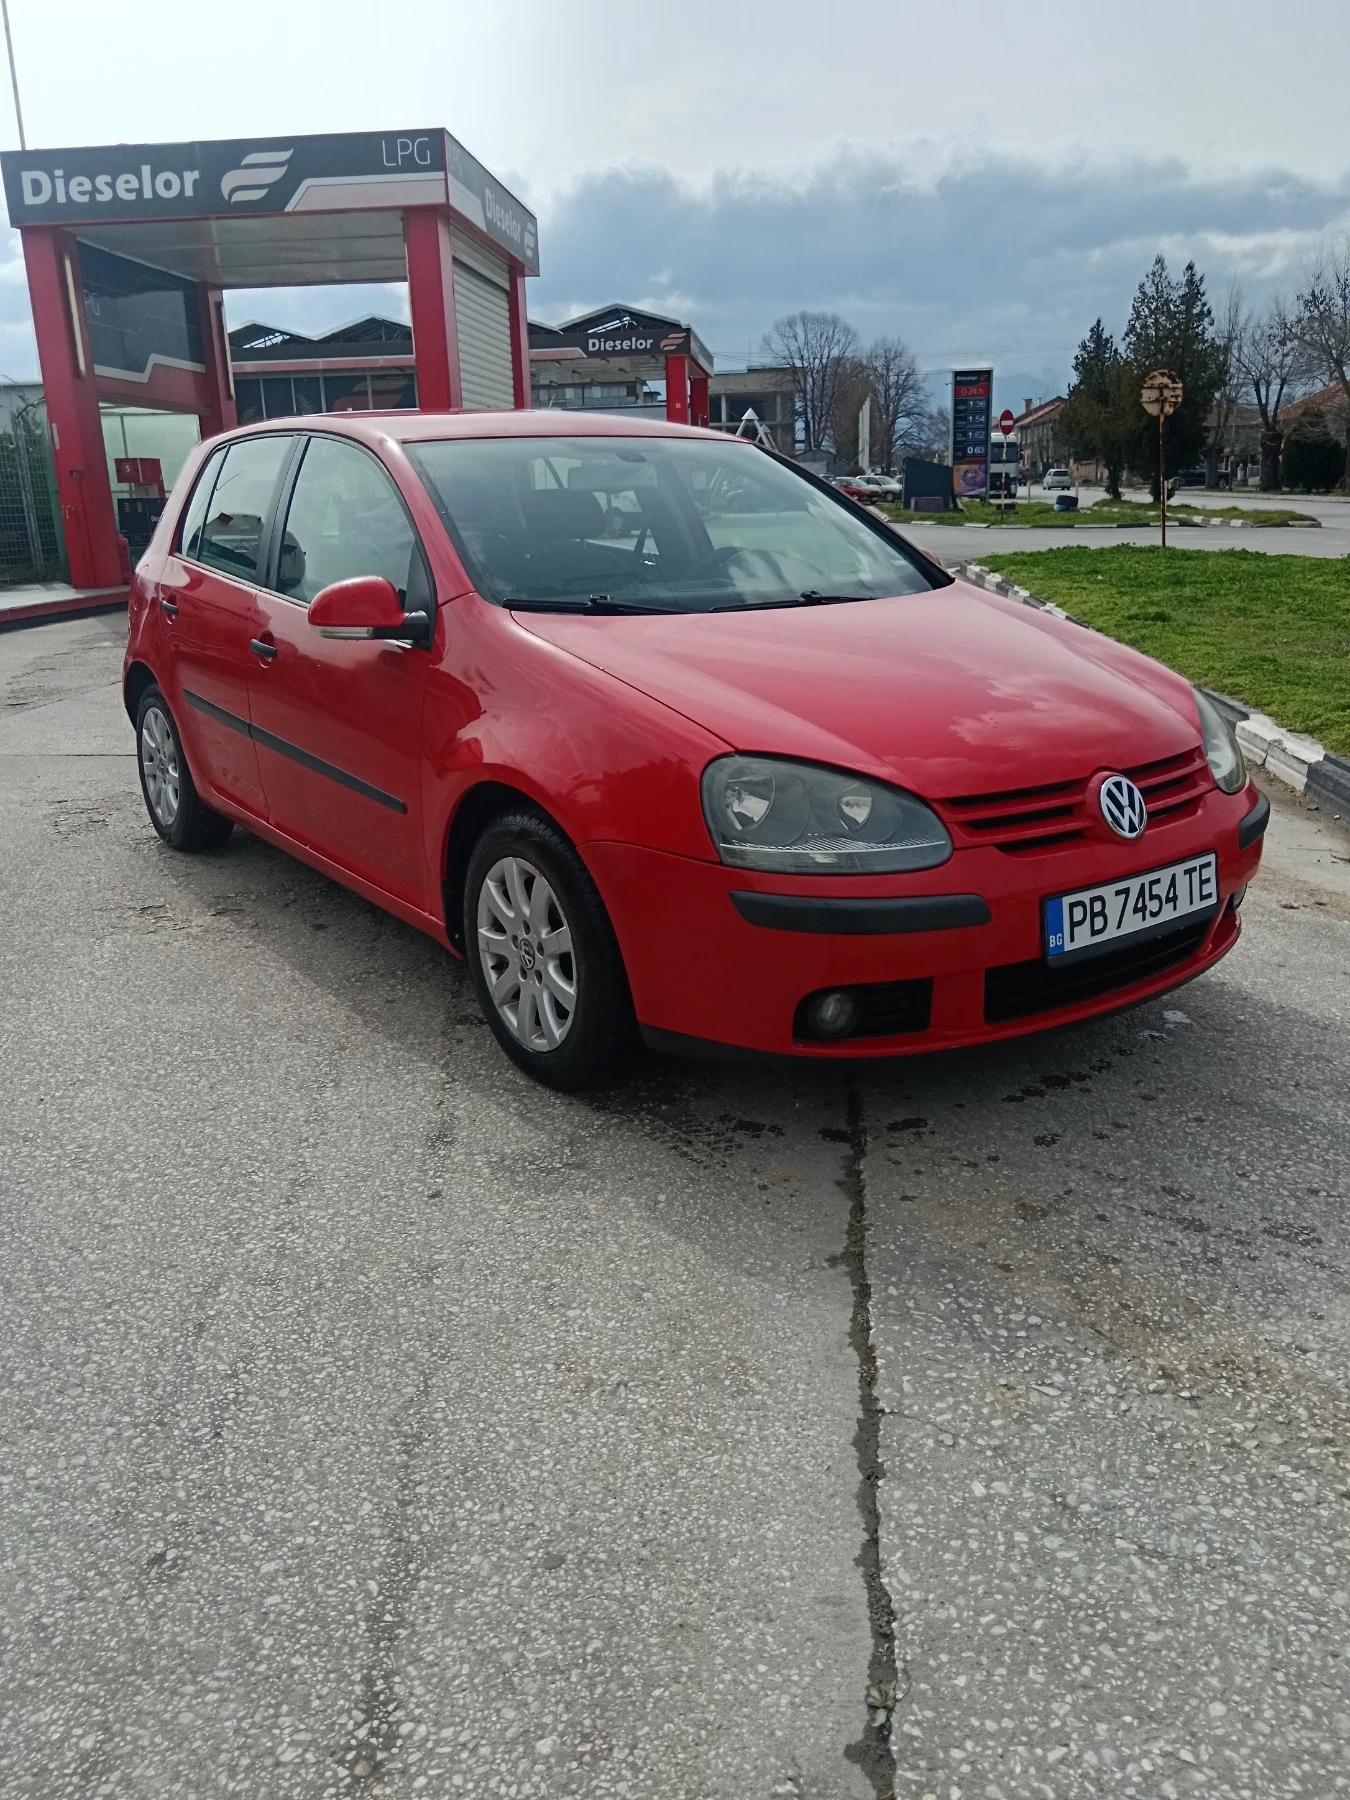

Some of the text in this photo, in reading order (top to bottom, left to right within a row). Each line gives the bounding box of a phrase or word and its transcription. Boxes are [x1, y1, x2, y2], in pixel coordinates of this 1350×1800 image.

[382, 137, 432, 167] LPG
[21, 164, 201, 205] Dieselor
[484, 186, 522, 243] Dieselor
[83, 289, 100, 316] PG
[588, 336, 653, 352] Dieselor
[961, 387, 977, 396] 0-24
[1101, 776, 1147, 839] VW
[1068, 860, 1213, 943] PB 7454 TE
[1049, 932, 1063, 948] BG
